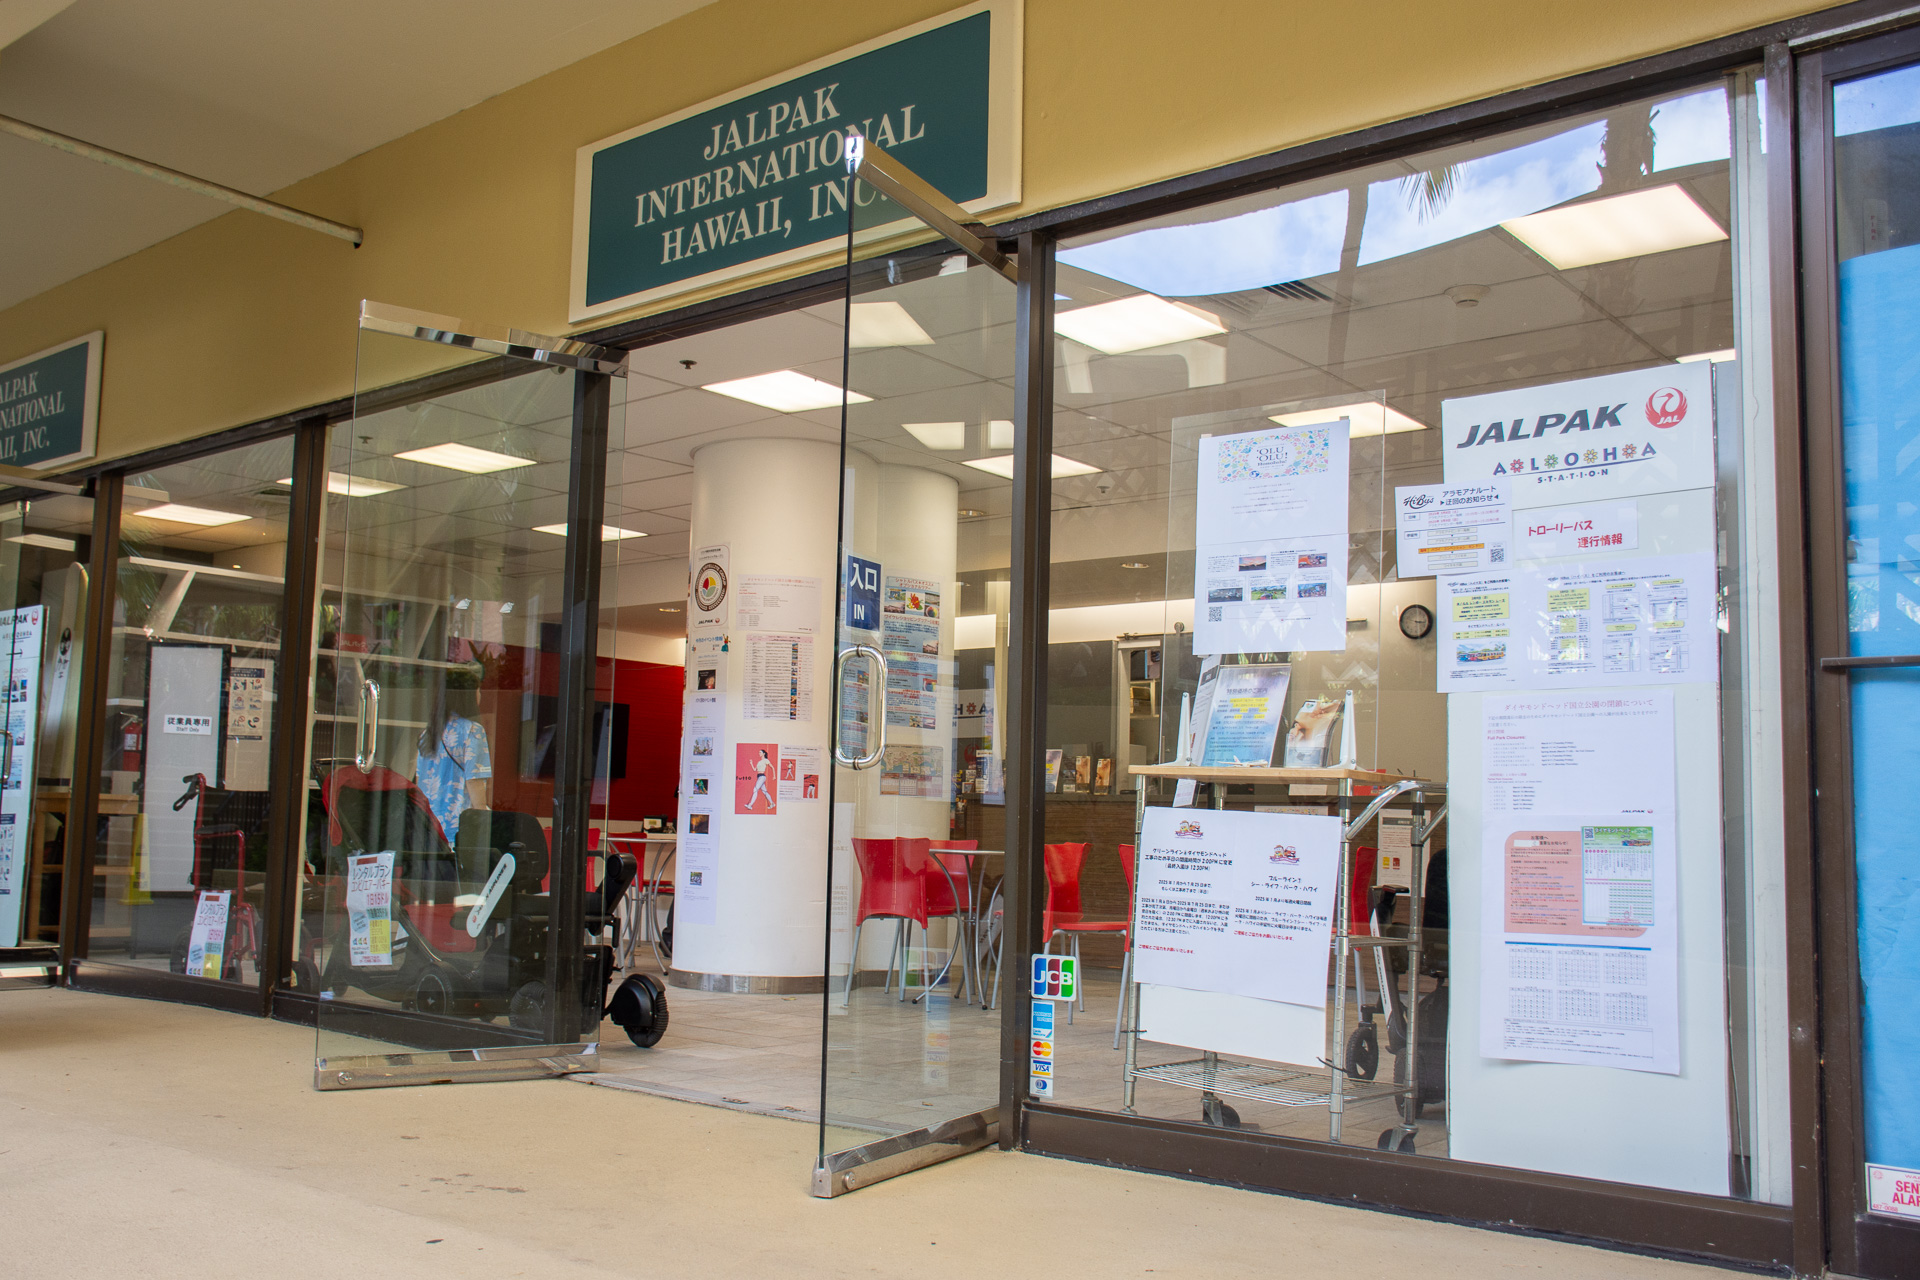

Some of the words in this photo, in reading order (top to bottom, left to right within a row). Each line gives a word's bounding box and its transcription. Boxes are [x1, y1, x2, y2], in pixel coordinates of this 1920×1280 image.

[703, 83, 840, 161] JALPAK
[660, 197, 792, 265] HAWAII,
[1456, 402, 1629, 449] JALPAK
[1656, 415, 1680, 425] JAL
[22, 426, 50, 453] INC.
[1442, 486, 1497, 498] アラモアナルート
[1528, 520, 1594, 536] トローリーバス
[1577, 533, 1623, 548] 運行情報
[850, 562, 878, 593] 入口
[854, 603, 865, 621] IN
[167, 717, 210, 726] 従業員専用
[352, 864, 391, 880] レンタルプラン
[1033, 970, 1073, 985] JCB
[1035, 1064, 1050, 1072] VISA
[1895, 1180, 1920, 1195] SEN
